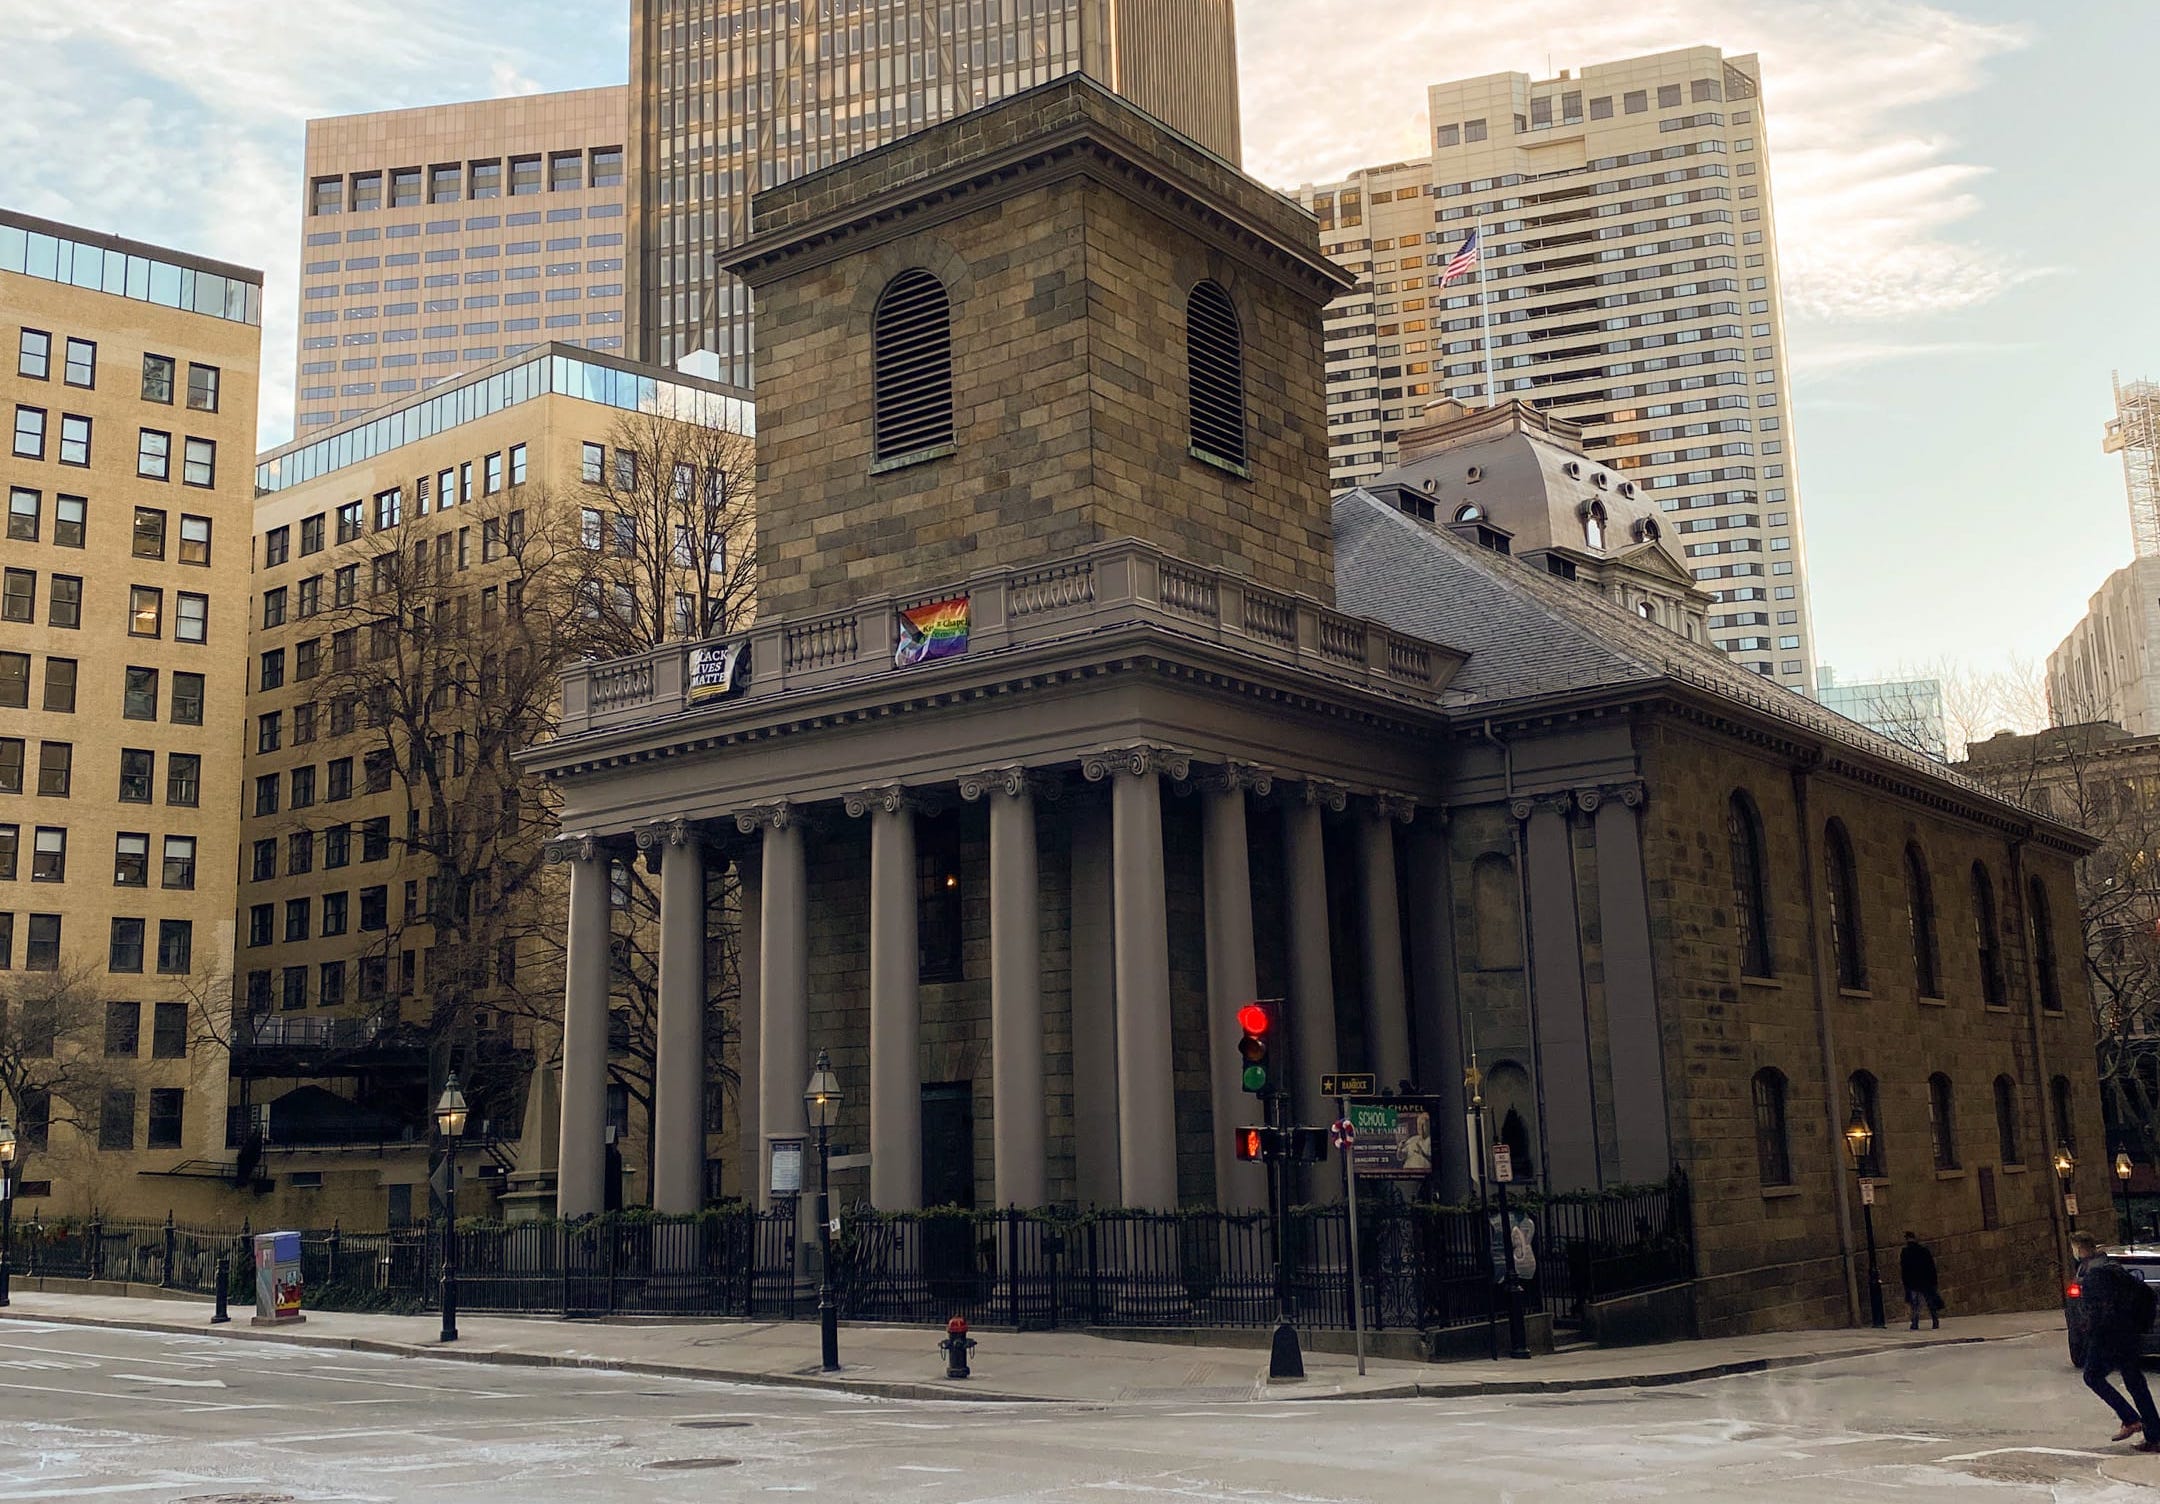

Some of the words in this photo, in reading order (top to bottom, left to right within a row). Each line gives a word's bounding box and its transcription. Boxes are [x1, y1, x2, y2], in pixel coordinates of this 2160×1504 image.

[697, 649, 728, 663] LACK
[692, 672, 726, 687] MATTE
[1358, 1111, 1388, 1127] SCHOOL
